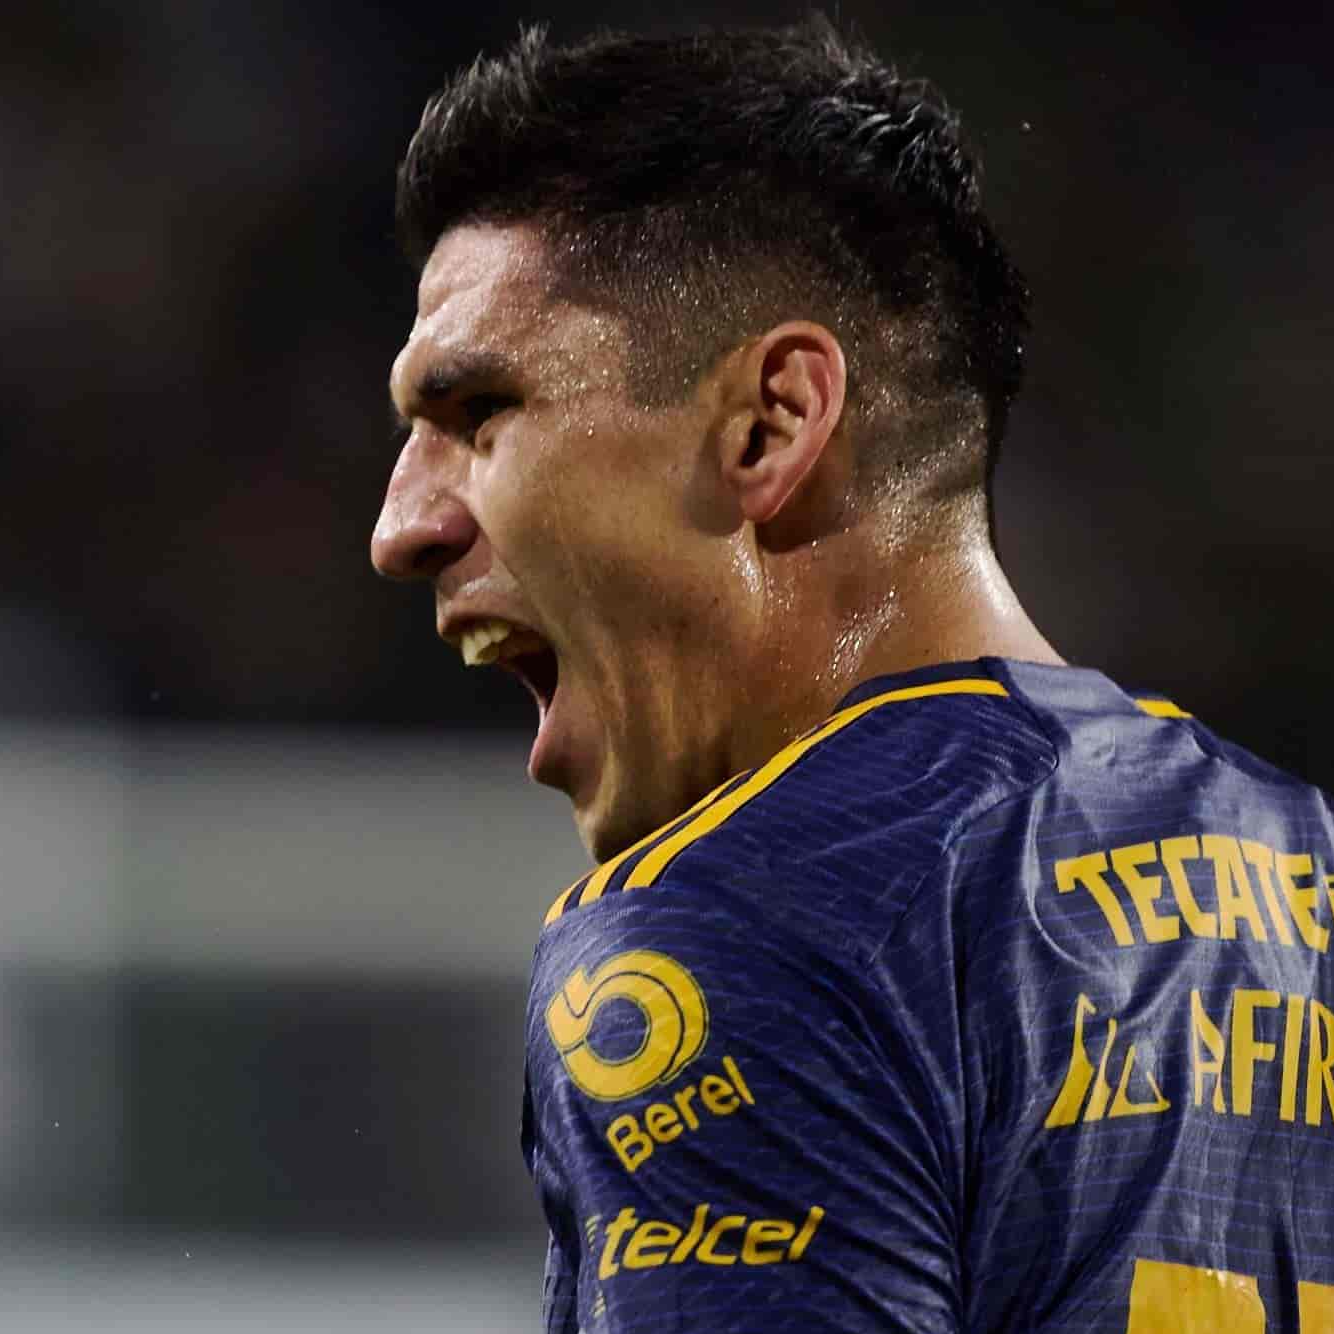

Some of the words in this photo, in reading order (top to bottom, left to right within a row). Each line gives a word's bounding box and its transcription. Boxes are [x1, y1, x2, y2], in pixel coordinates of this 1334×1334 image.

[1055, 835, 1329, 952] TECATE
[606, 1056, 755, 1172] Berel
[598, 1203, 826, 1280] telcel
